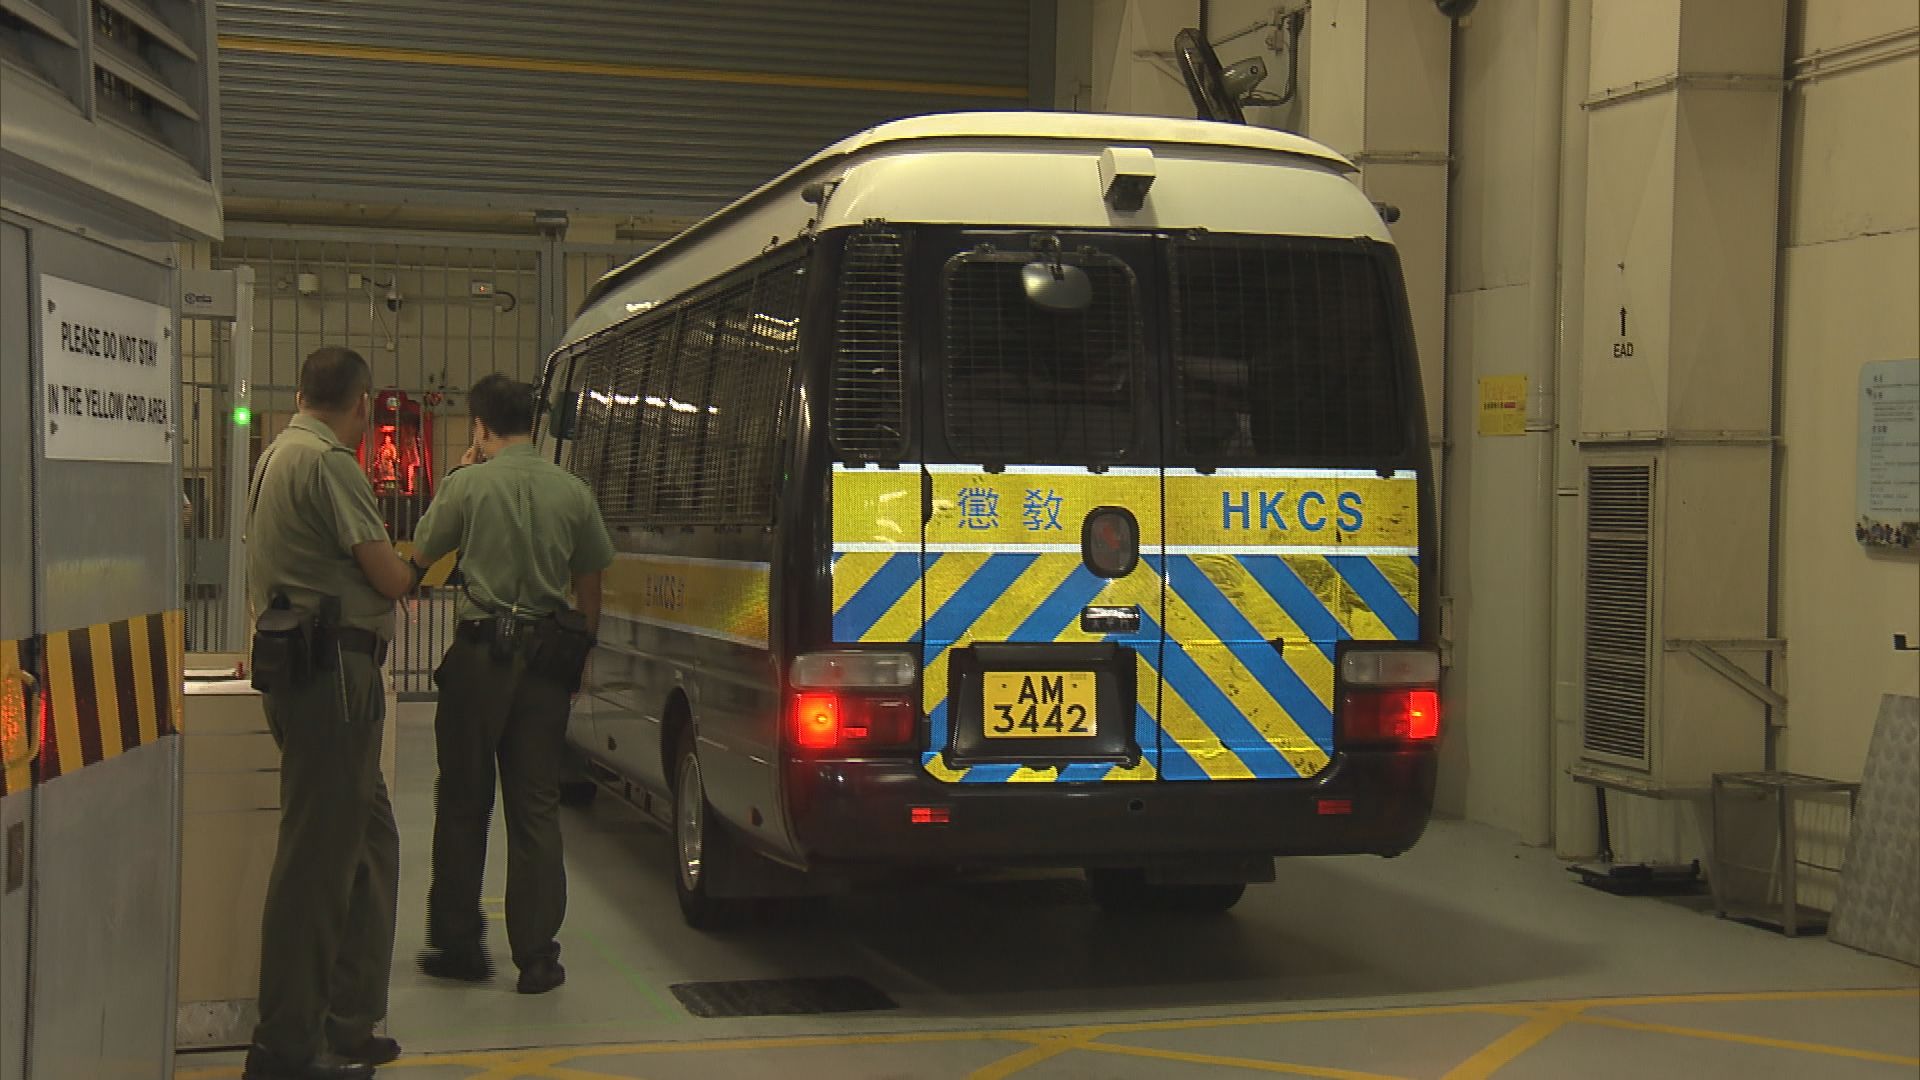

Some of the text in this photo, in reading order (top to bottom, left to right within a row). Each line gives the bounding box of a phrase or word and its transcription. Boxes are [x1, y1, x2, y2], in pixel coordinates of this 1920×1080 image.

[61, 321, 158, 367] PLEASE DO NOT STAY
[1613, 342, 1634, 358] EAD
[48, 383, 167, 424] IN THE YELLOW GRID AREA
[1222, 491, 1364, 532] HKCS
[1017, 675, 1064, 704] AM
[993, 703, 1089, 733] 3442
